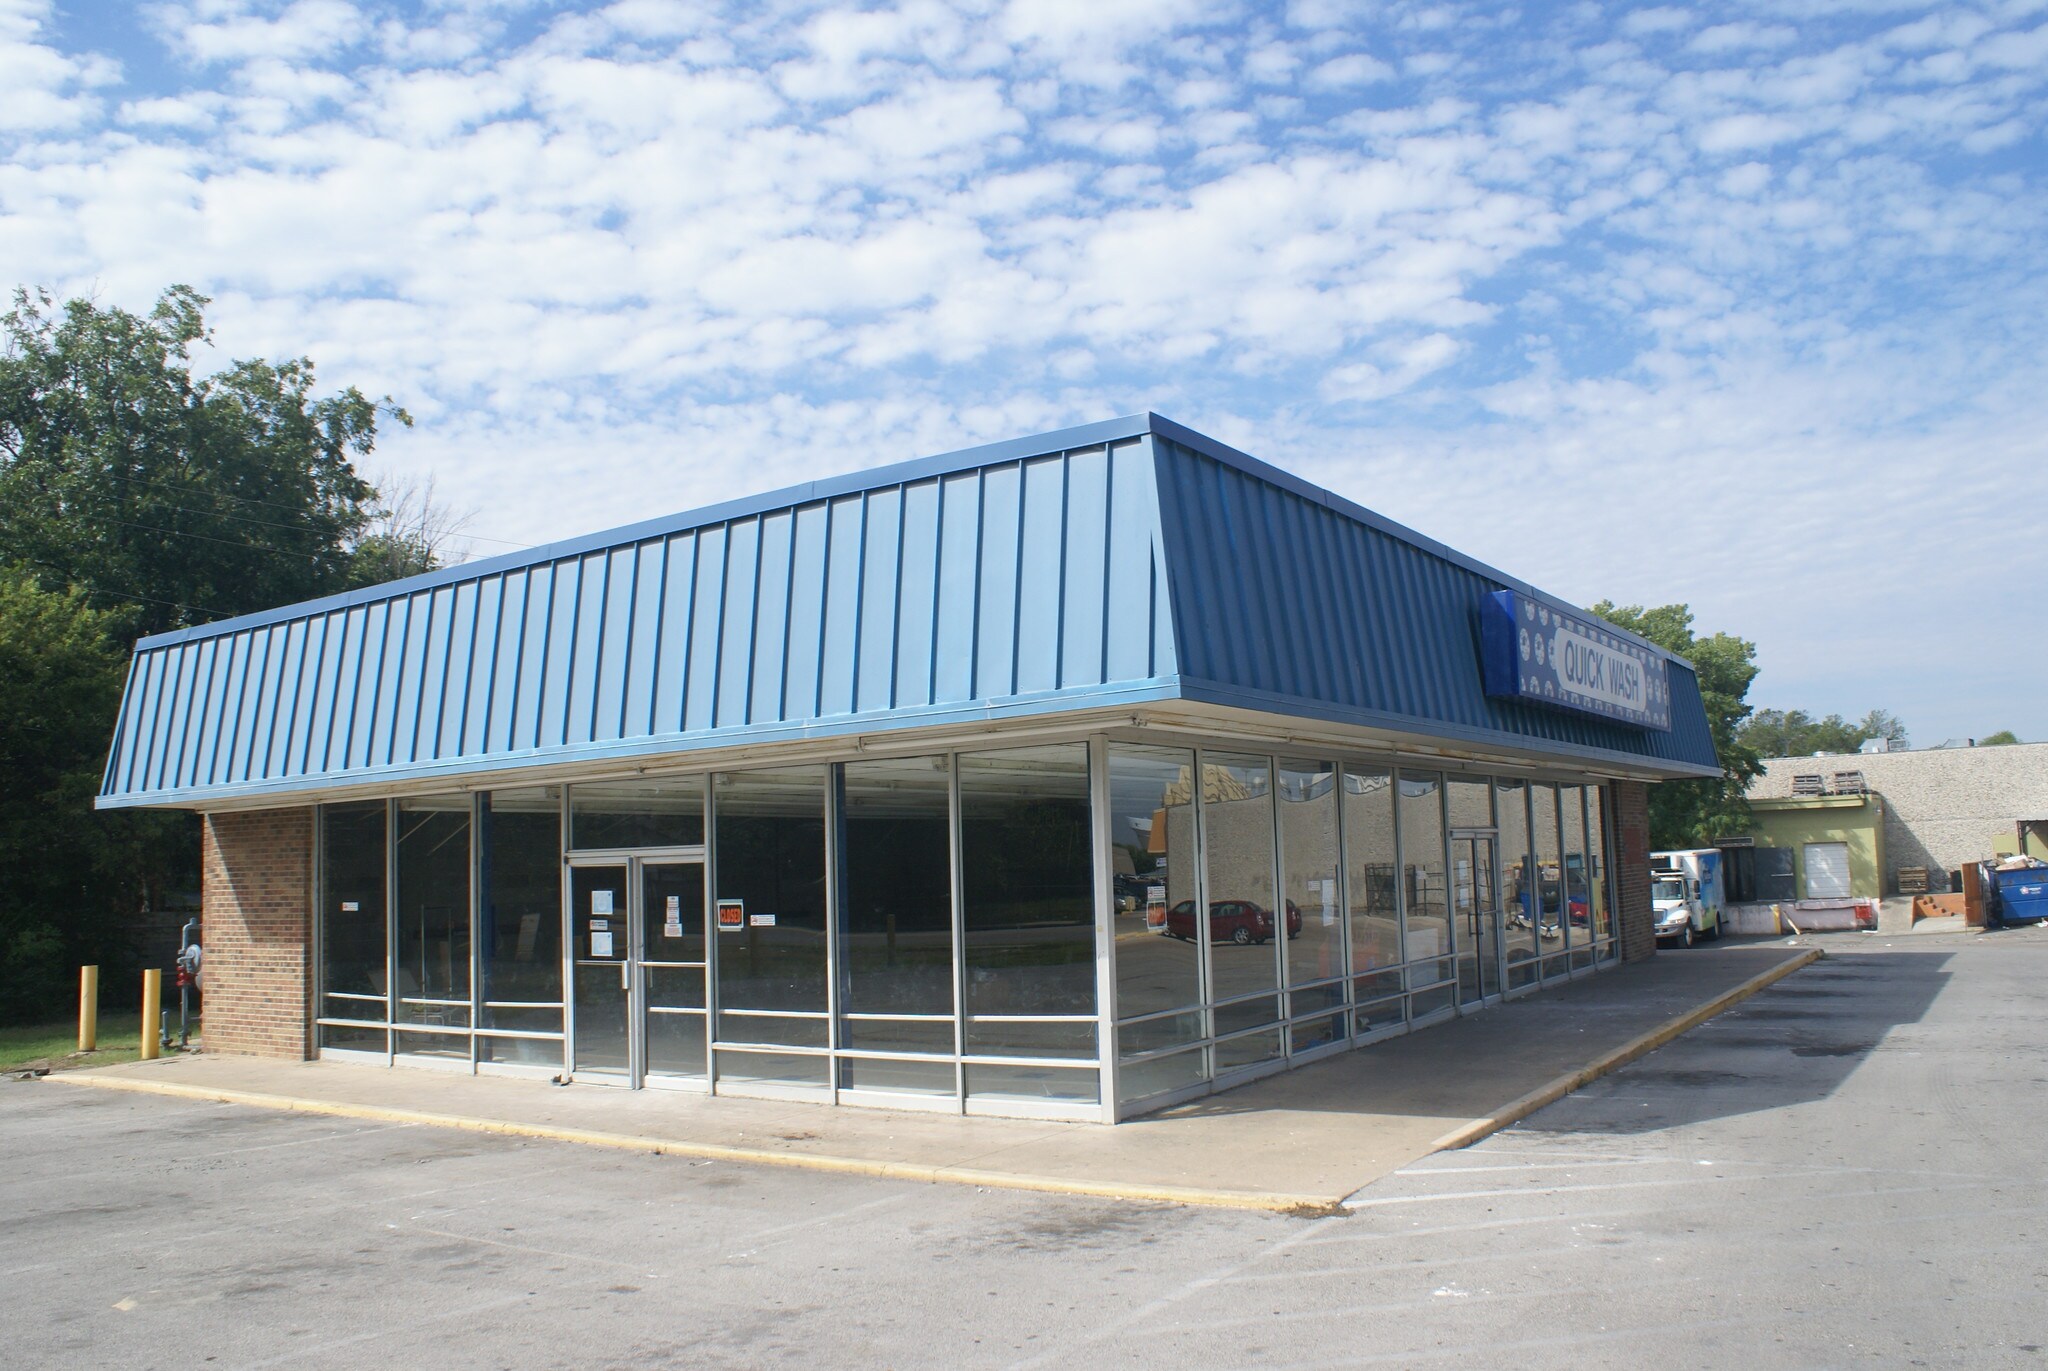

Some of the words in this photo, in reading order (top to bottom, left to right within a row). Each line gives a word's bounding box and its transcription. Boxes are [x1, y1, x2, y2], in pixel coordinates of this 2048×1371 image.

[1565, 640, 1604, 691] QUICK
[1608, 657, 1639, 702] WASH
[720, 908, 741, 923] CLOSED
